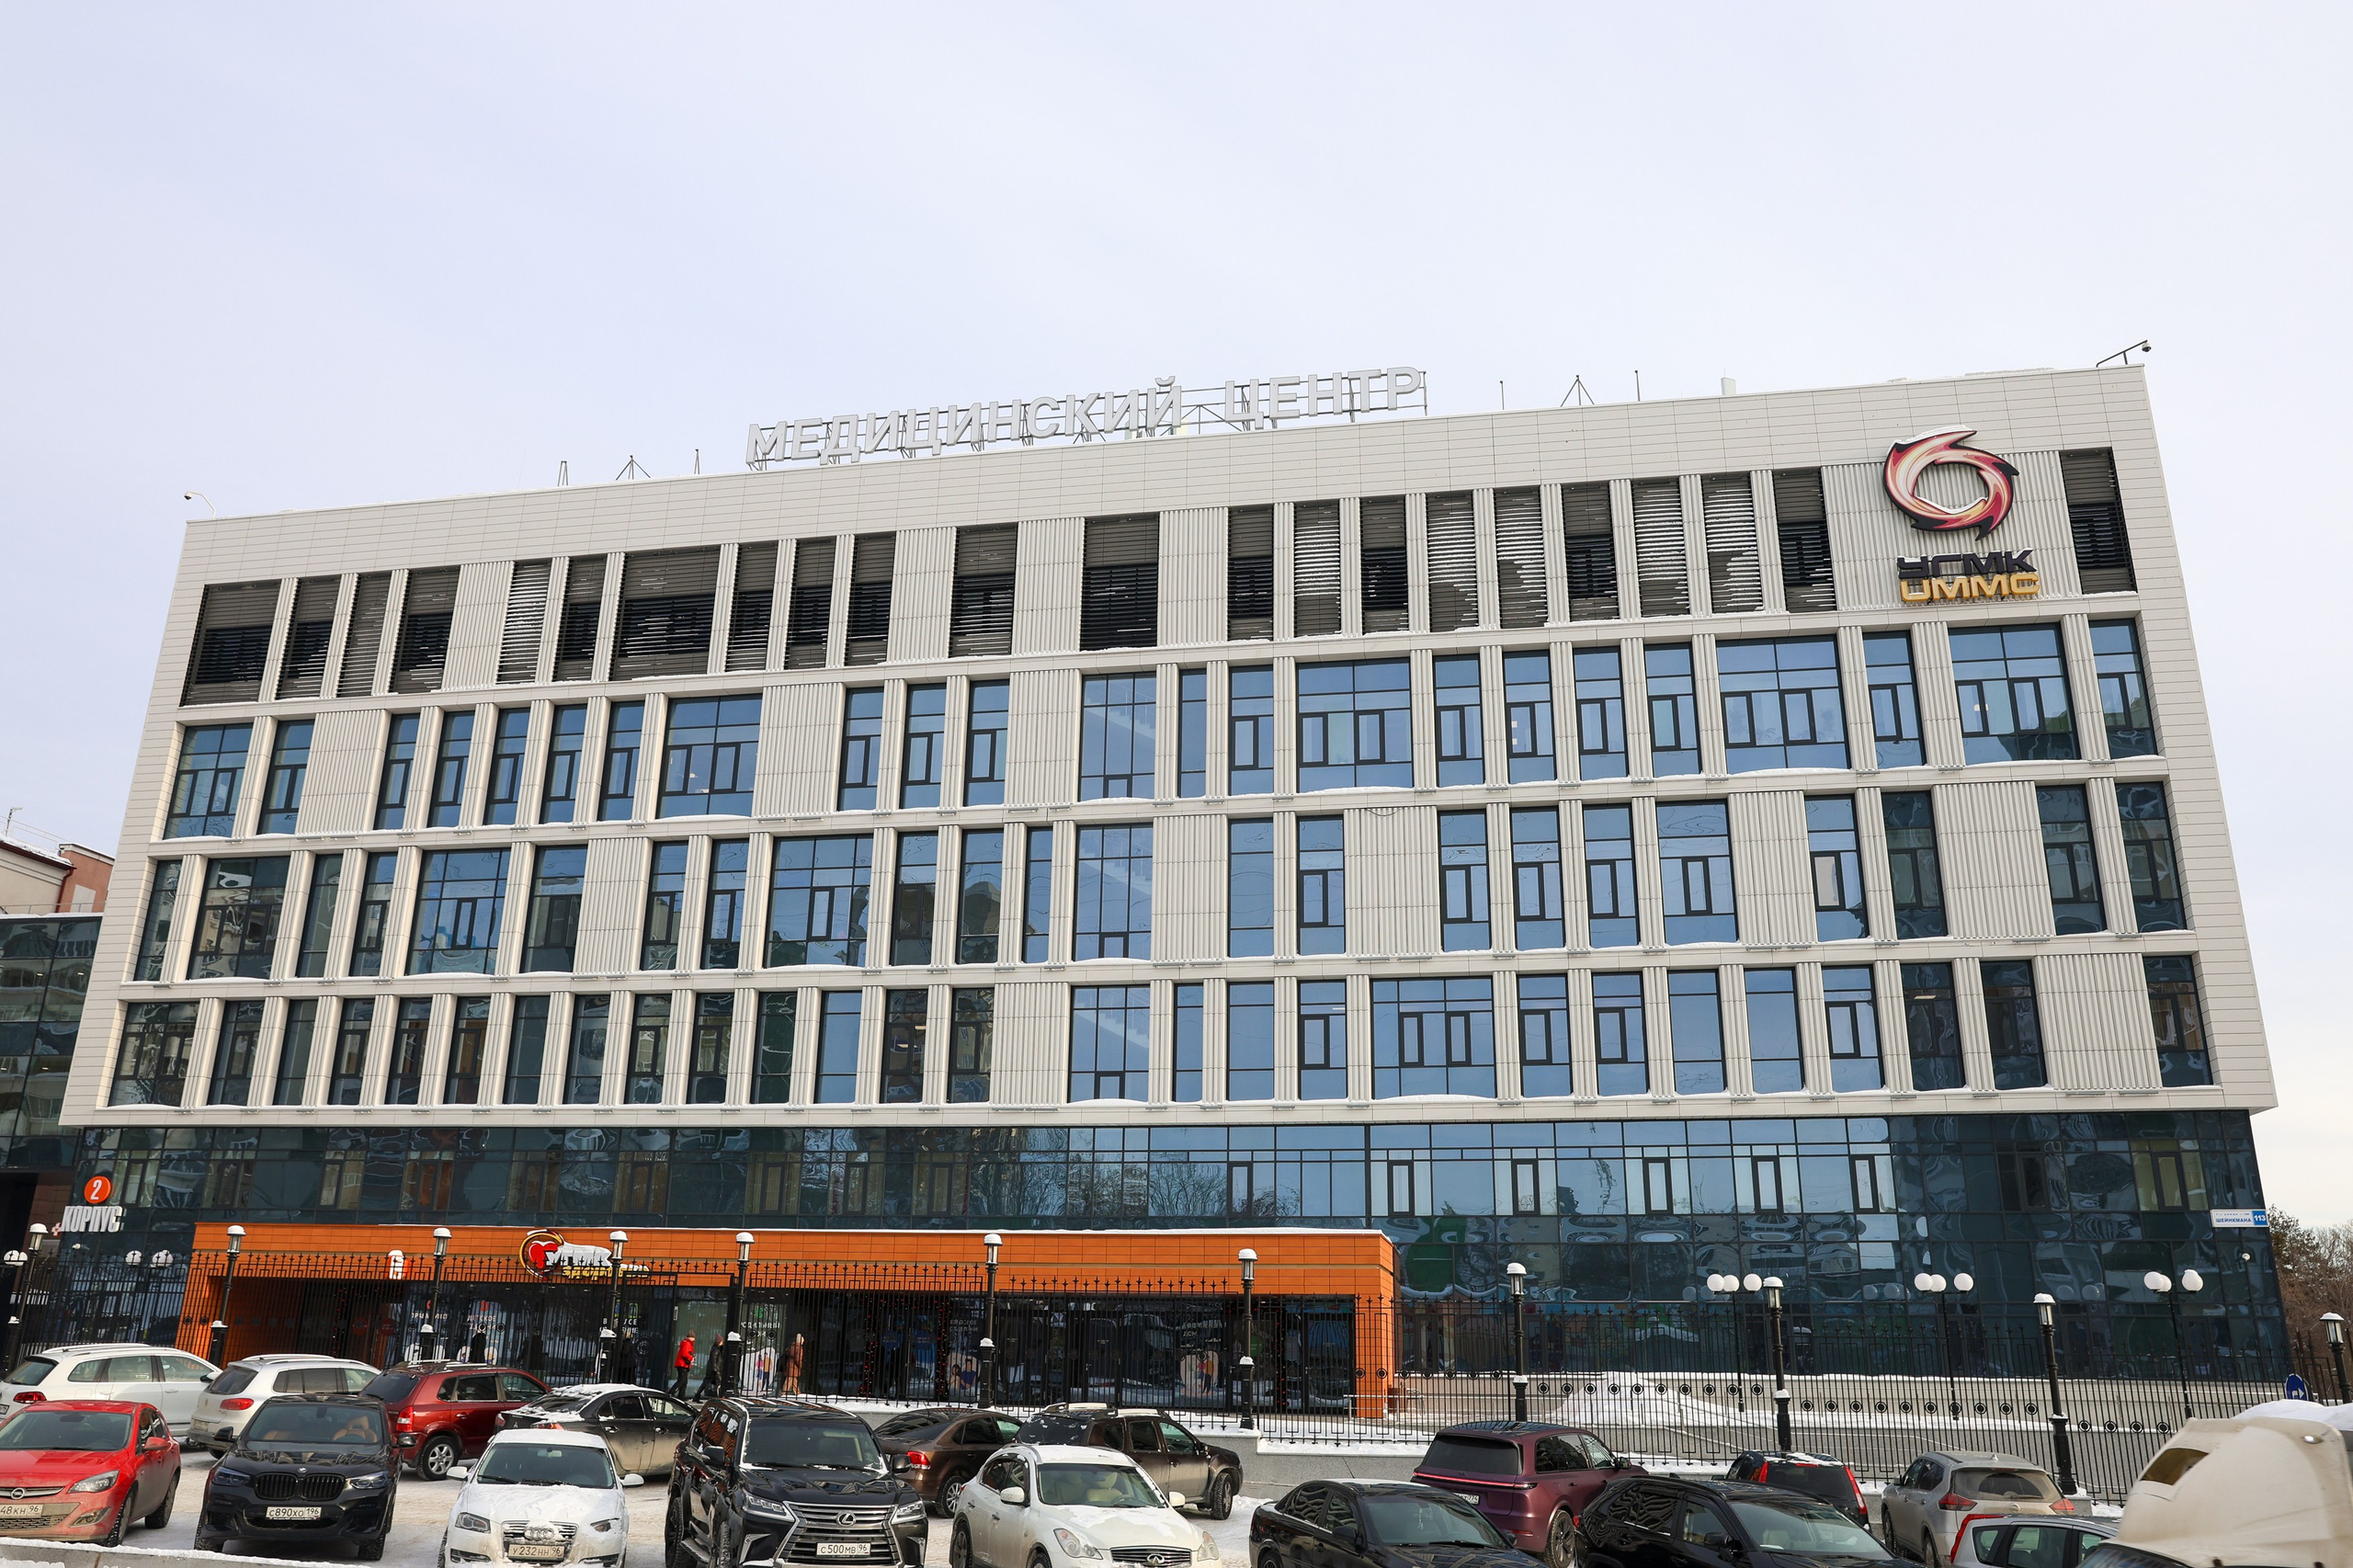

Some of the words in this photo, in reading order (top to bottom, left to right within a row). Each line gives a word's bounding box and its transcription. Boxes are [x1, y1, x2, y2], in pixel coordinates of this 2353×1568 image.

[746, 375, 1182, 464] МЕДИЦИНСКИЙ
[1223, 367, 1422, 430] ЦЕНТР
[1897, 549, 2038, 579] УГМК
[1900, 573, 2040, 602] UMMC
[90, 1179, 102, 1200] 2
[60, 1205, 123, 1233] КОРПУС
[28, 1505, 39, 1513] 96
[268, 1507, 304, 1517] С890ХО
[512, 1546, 549, 1556] У232НН
[551, 1546, 561, 1554] 96
[820, 1544, 856, 1554] С500МВ
[858, 1543, 868, 1551] 96
